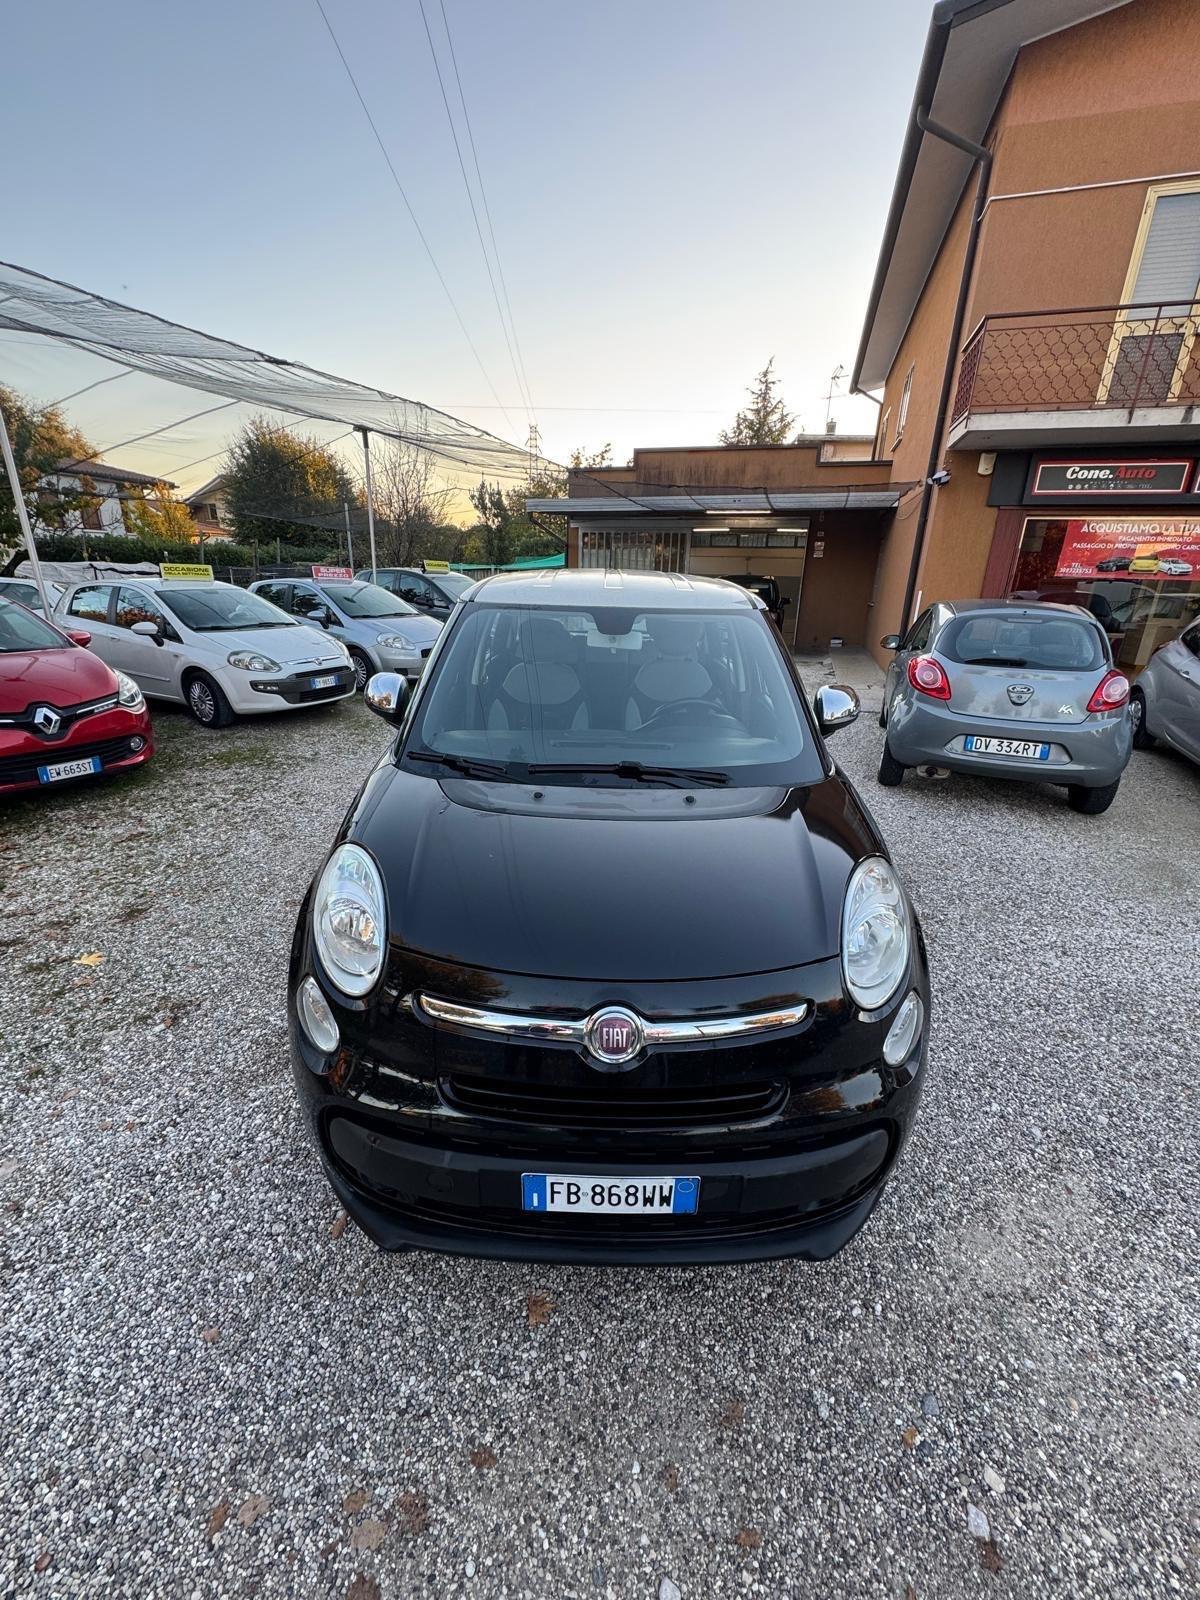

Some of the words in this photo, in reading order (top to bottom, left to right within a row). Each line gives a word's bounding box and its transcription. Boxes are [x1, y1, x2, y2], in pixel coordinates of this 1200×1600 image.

[1081, 523, 1160, 533] ACQUISTIAMO
[1162, 524, 1175, 534] LA
[974, 738, 991, 751] DV
[996, 740, 1040, 756] 334RT
[49, 767, 61, 778] EW
[63, 761, 92, 776] 663ST
[602, 1027, 629, 1048] FIAT
[550, 1182, 581, 1205] FB
[590, 1184, 673, 1207] 868WW
